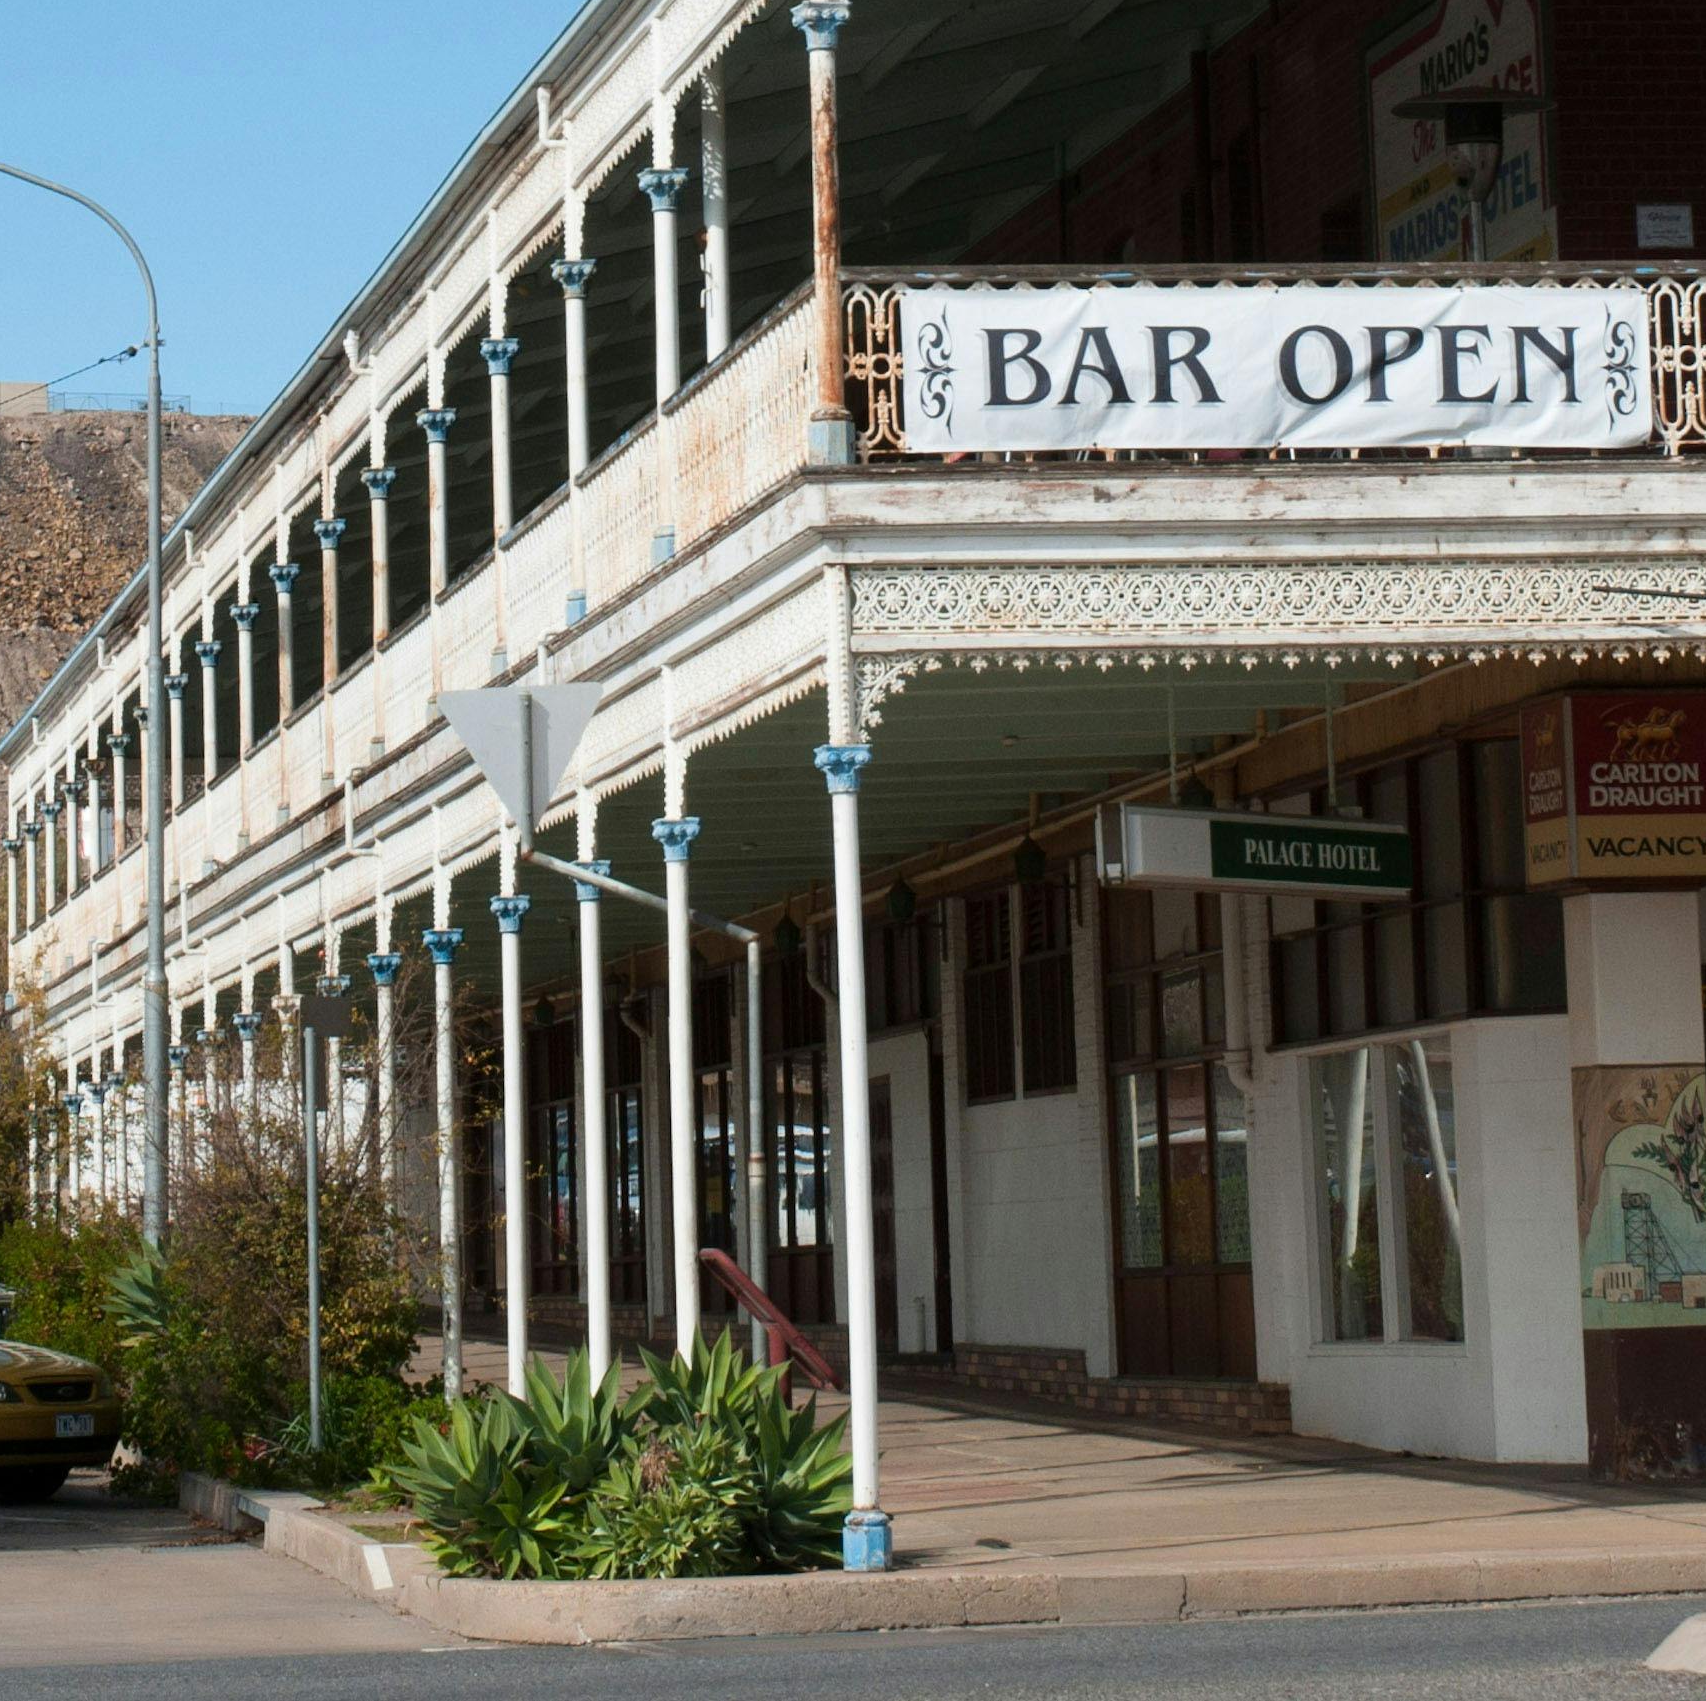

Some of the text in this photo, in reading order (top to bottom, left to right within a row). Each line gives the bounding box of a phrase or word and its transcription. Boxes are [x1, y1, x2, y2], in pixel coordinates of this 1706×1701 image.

[980, 324, 1582, 407] BAR OPEN
[1590, 762, 1701, 784] CARLTON
[1589, 785, 1704, 807] DRAUGHT
[1245, 838, 1381, 872] PALACE HOTEL
